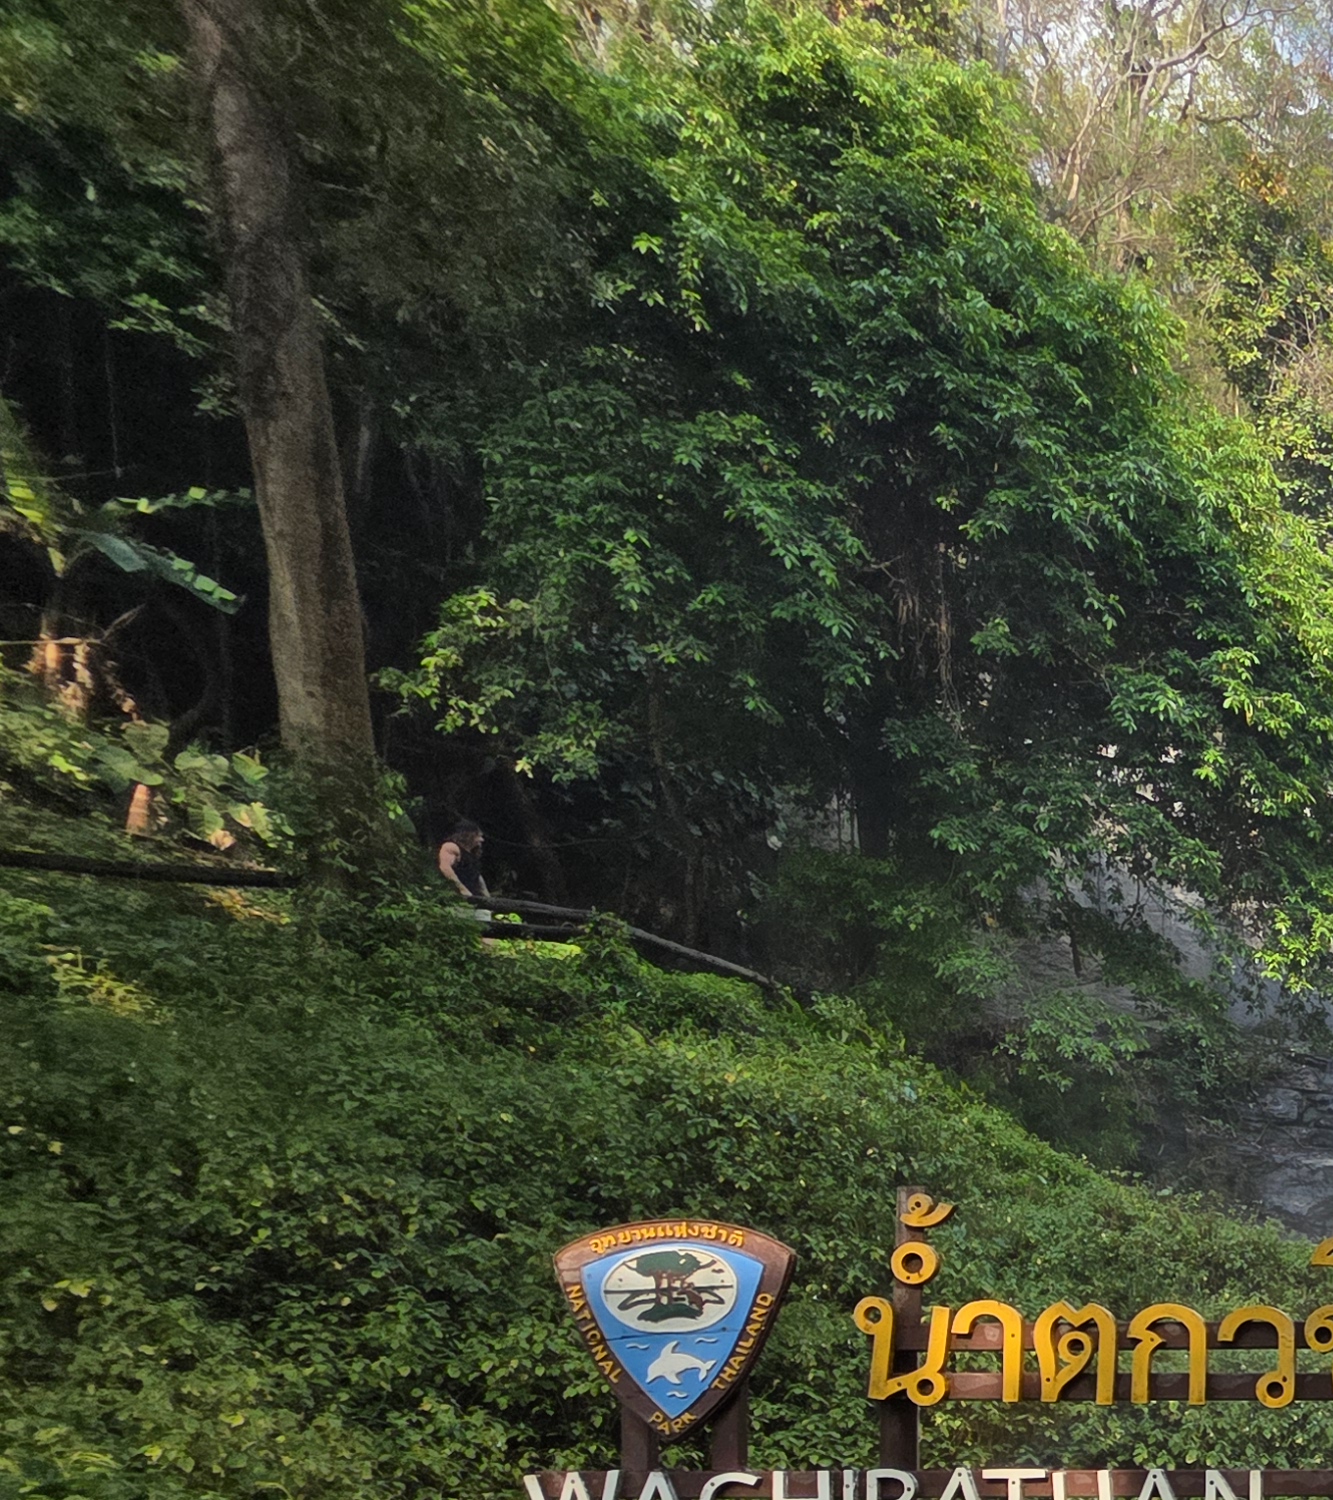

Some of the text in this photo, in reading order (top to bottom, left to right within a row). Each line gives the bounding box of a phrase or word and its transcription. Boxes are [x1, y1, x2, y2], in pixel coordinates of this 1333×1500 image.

[589, 1221, 745, 1255] อุทยานแห่งชาติ
[566, 1284, 622, 1384] NATIONAL
[710, 1292, 775, 1391] THAILAND
[648, 1410, 697, 1435] PARK
